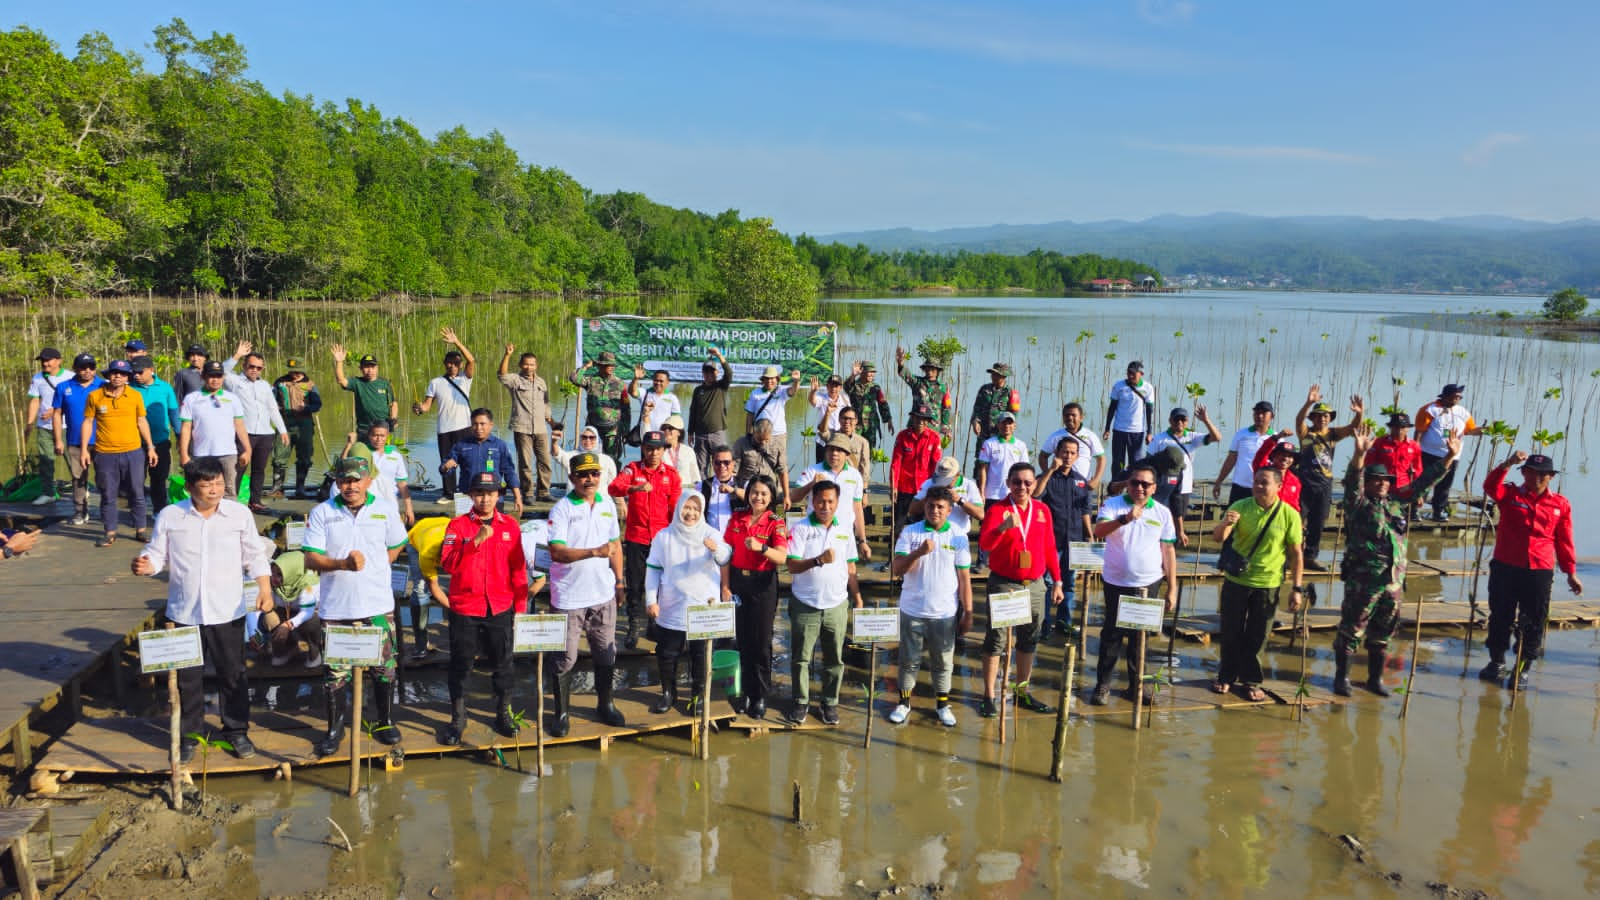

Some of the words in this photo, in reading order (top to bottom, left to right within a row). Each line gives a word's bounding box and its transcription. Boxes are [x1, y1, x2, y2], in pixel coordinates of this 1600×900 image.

[649, 327, 729, 341] PENANAMAN
[732, 330, 776, 343] POHON
[618, 343, 680, 358] SERENTAK
[683, 346, 737, 359] SELUUH
[740, 347, 805, 361] INDONESIA
